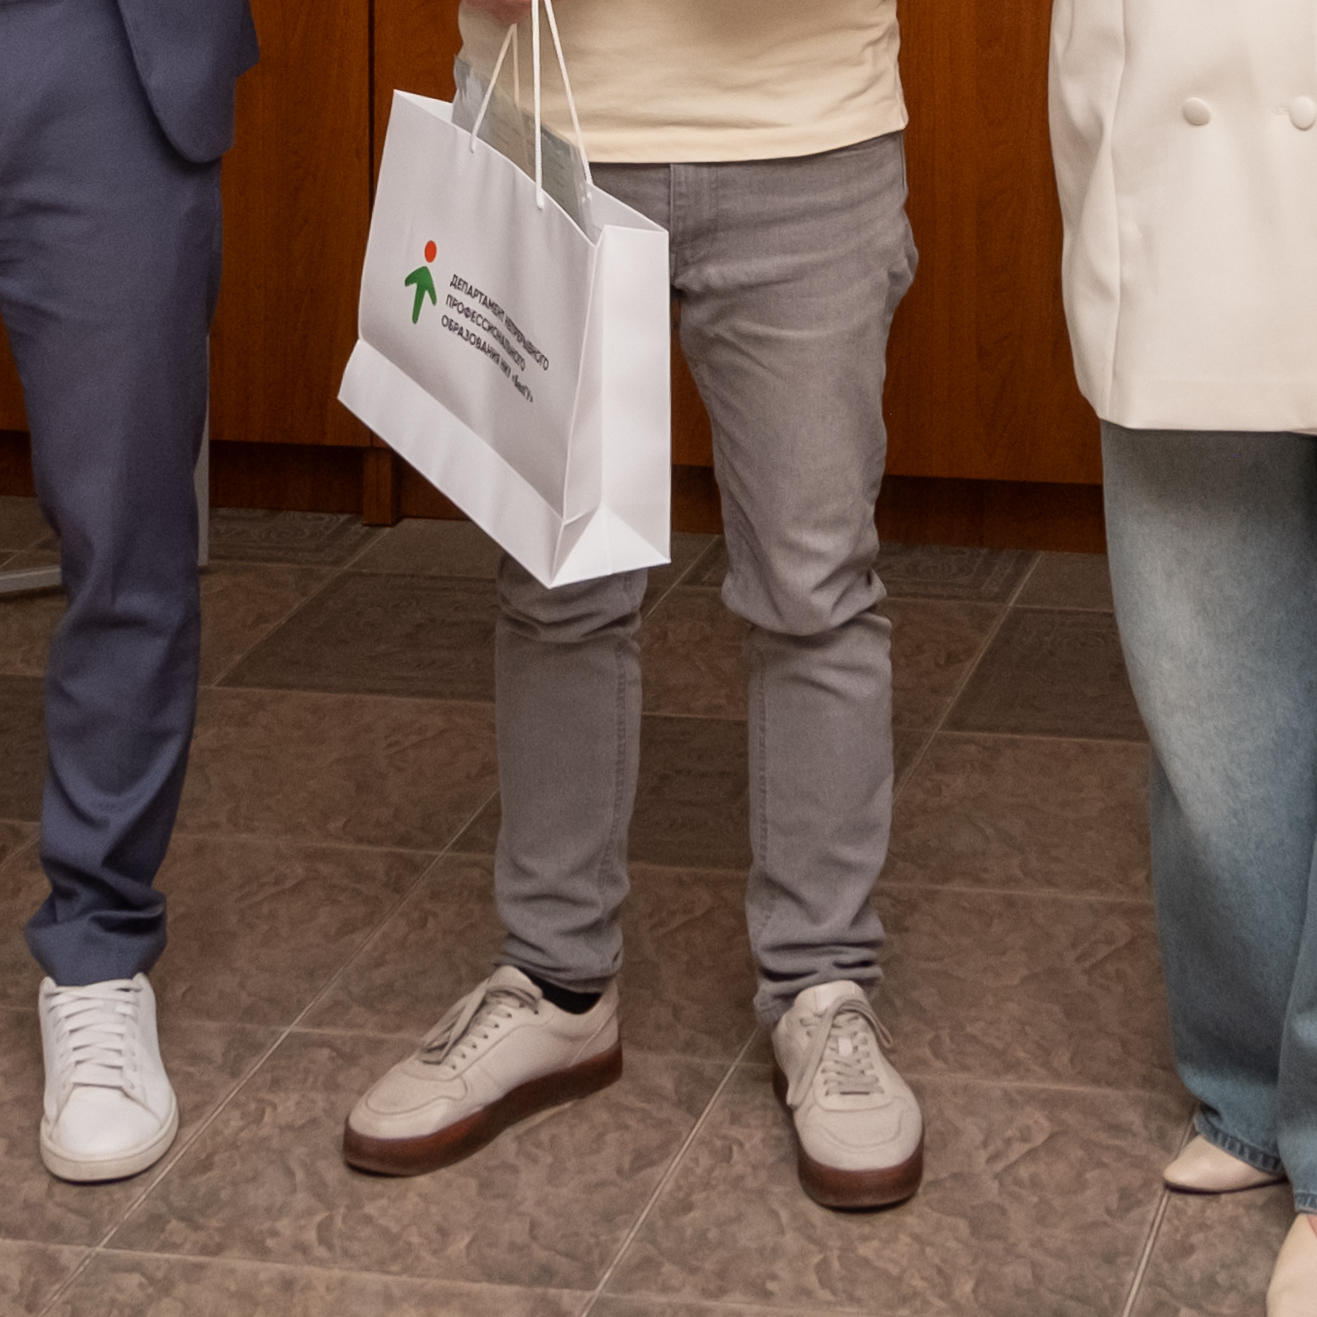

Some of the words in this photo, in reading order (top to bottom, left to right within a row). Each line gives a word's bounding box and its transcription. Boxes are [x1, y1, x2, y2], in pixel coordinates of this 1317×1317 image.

[449, 274, 505, 323] ДЕПАРТАМЕНТ
[441, 315, 501, 365] ОБРАЗОВАНИЯ
[445, 294, 526, 371] ПРОФЕССИОНАЛЬНОГО
